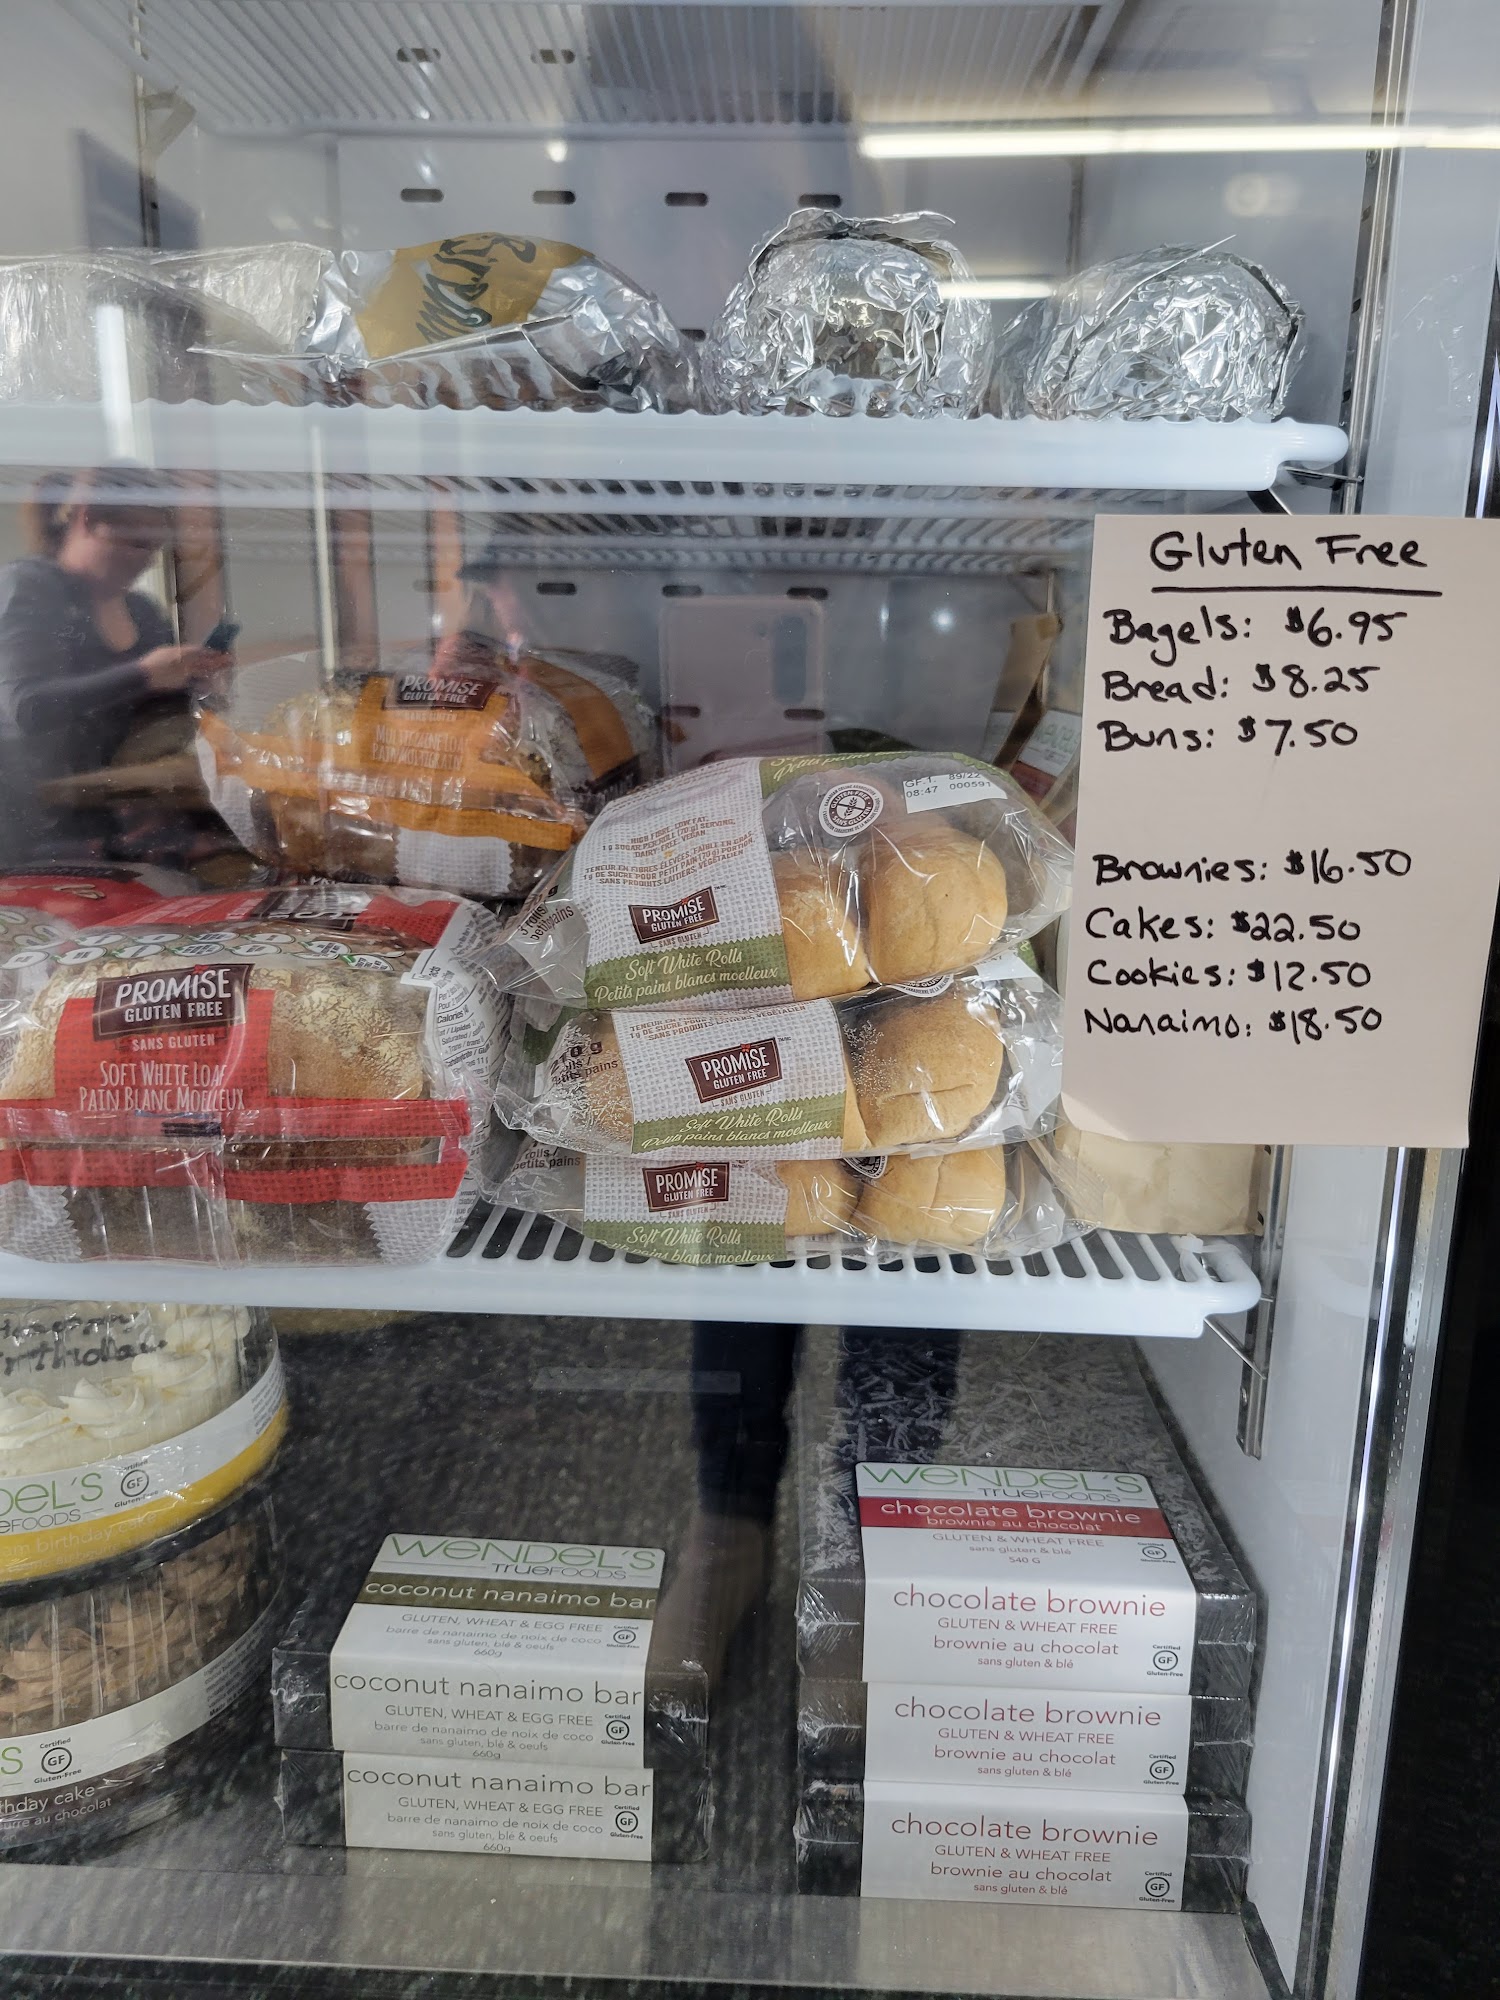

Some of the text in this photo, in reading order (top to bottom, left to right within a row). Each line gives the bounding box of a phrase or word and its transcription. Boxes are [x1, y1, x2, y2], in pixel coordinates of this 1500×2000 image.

[1150, 527, 1428, 572] Gluten Free
[1103, 605, 1408, 667] Bagels: $6.95
[401, 674, 484, 696] PROMISE
[1102, 663, 1381, 704] Bread: $8.25
[1097, 719, 1214, 753] Buns:
[1238, 715, 1358, 756] $7.50
[906, 780, 991, 798] 08:47 000591
[1093, 848, 1412, 886] Brownies: $16.50
[642, 895, 706, 924] PROMISE
[651, 912, 704, 933] GLUTEN FREE
[1086, 906, 1361, 942] Cakes: $22.50
[625, 947, 743, 981] Soft White Rolls
[1087, 957, 1371, 992] Cookies: $12.50
[115, 969, 231, 1008] PROMISE
[594, 964, 780, 1003] Petits pains blancs moelleux
[125, 1001, 223, 1023] GLUTEN FREE
[1084, 1005, 1382, 1045] Nanaimo: $18.50
[132, 1034, 215, 1051] SANS GLUTEN
[701, 1046, 770, 1081] PROMISE
[713, 1068, 767, 1090] GLUTEN FREE
[714, 1113, 763, 1133] White
[765, 1107, 803, 1128] Rolls
[682, 1130, 722, 1144] pains
[726, 1128, 770, 1143] blancs
[512, 1156, 581, 1173] petits pains
[525, 1148, 550, 1160] rolls
[655, 1167, 719, 1194] PROMISE
[664, 1187, 714, 1203] GLUTEN FREE
[626, 1225, 742, 1248] Soft White Rolls
[671, 1249, 713, 1266] blancs
[127, 1476, 144, 1489] GF
[881, 1499, 1142, 1524] chocolate brownie
[926, 1516, 1102, 1532] brownie au chocolat
[365, 1582, 656, 1610] coconut nanaimo bar
[894, 1583, 1167, 1617] chocolate brownie
[937, 1617, 1118, 1635] GLUTEN & WHEAT FREE
[933, 1635, 1119, 1656] brownie au chocolat
[977, 1656, 1074, 1670] sans gluten & blé
[1157, 1655, 1174, 1666] GF
[334, 1673, 642, 1706] coconut nanaimo bar
[894, 1696, 1162, 1727] chocolate brownie
[39, 1737, 72, 1750] Certified
[47, 1754, 66, 1767] GF
[33, 1769, 82, 1784] Gluten-Free
[347, 1768, 651, 1797] coconut nanaimo bar
[54, 1785, 95, 1805] cake
[34, 1797, 112, 1826] au chocolat
[398, 1796, 604, 1817] GLUTEN, WHEAT & EGG FREE
[387, 1812, 604, 1835] barre de nanaimo de noix de coco
[619, 1816, 634, 1827] GF
[891, 1812, 1158, 1846] chocolate brownie
[432, 1829, 456, 1838] sans
[498, 1830, 516, 1841] blé
[518, 1832, 527, 1842] &
[529, 1832, 559, 1844] oeufs
[483, 1842, 511, 1854] 660g
[934, 1844, 1111, 1863] GLUTEN & WHEAT FREE
[930, 1862, 1113, 1883] brownie au chocolat
[974, 1882, 1068, 1896] sans gluten & blé
[1149, 1882, 1165, 1892] GF
